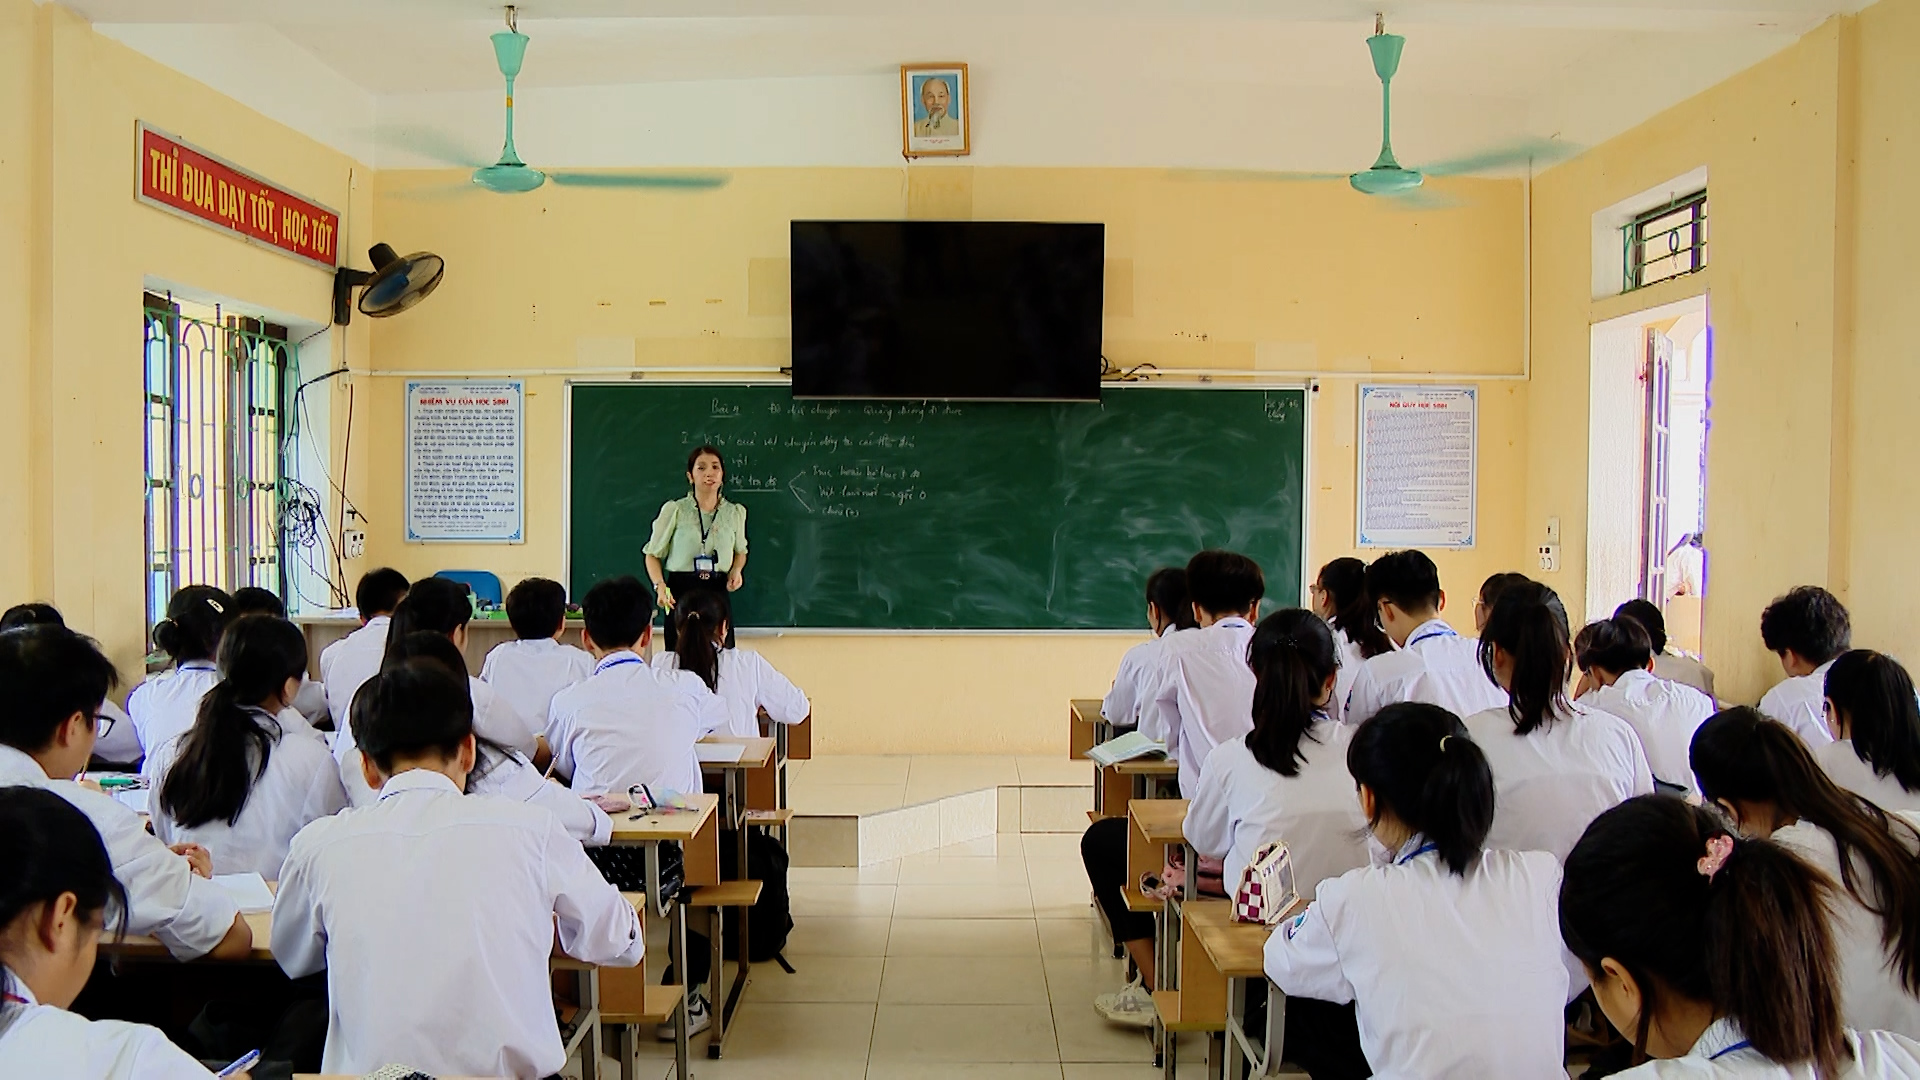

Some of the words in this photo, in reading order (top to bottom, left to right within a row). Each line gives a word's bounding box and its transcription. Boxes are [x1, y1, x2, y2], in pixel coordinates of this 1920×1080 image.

[182, 163, 215, 212] ĐUA
[218, 179, 247, 230] DẠY
[250, 189, 279, 244] TỐT,
[282, 205, 309, 252] HỌC
[311, 215, 333, 256] TỐT
